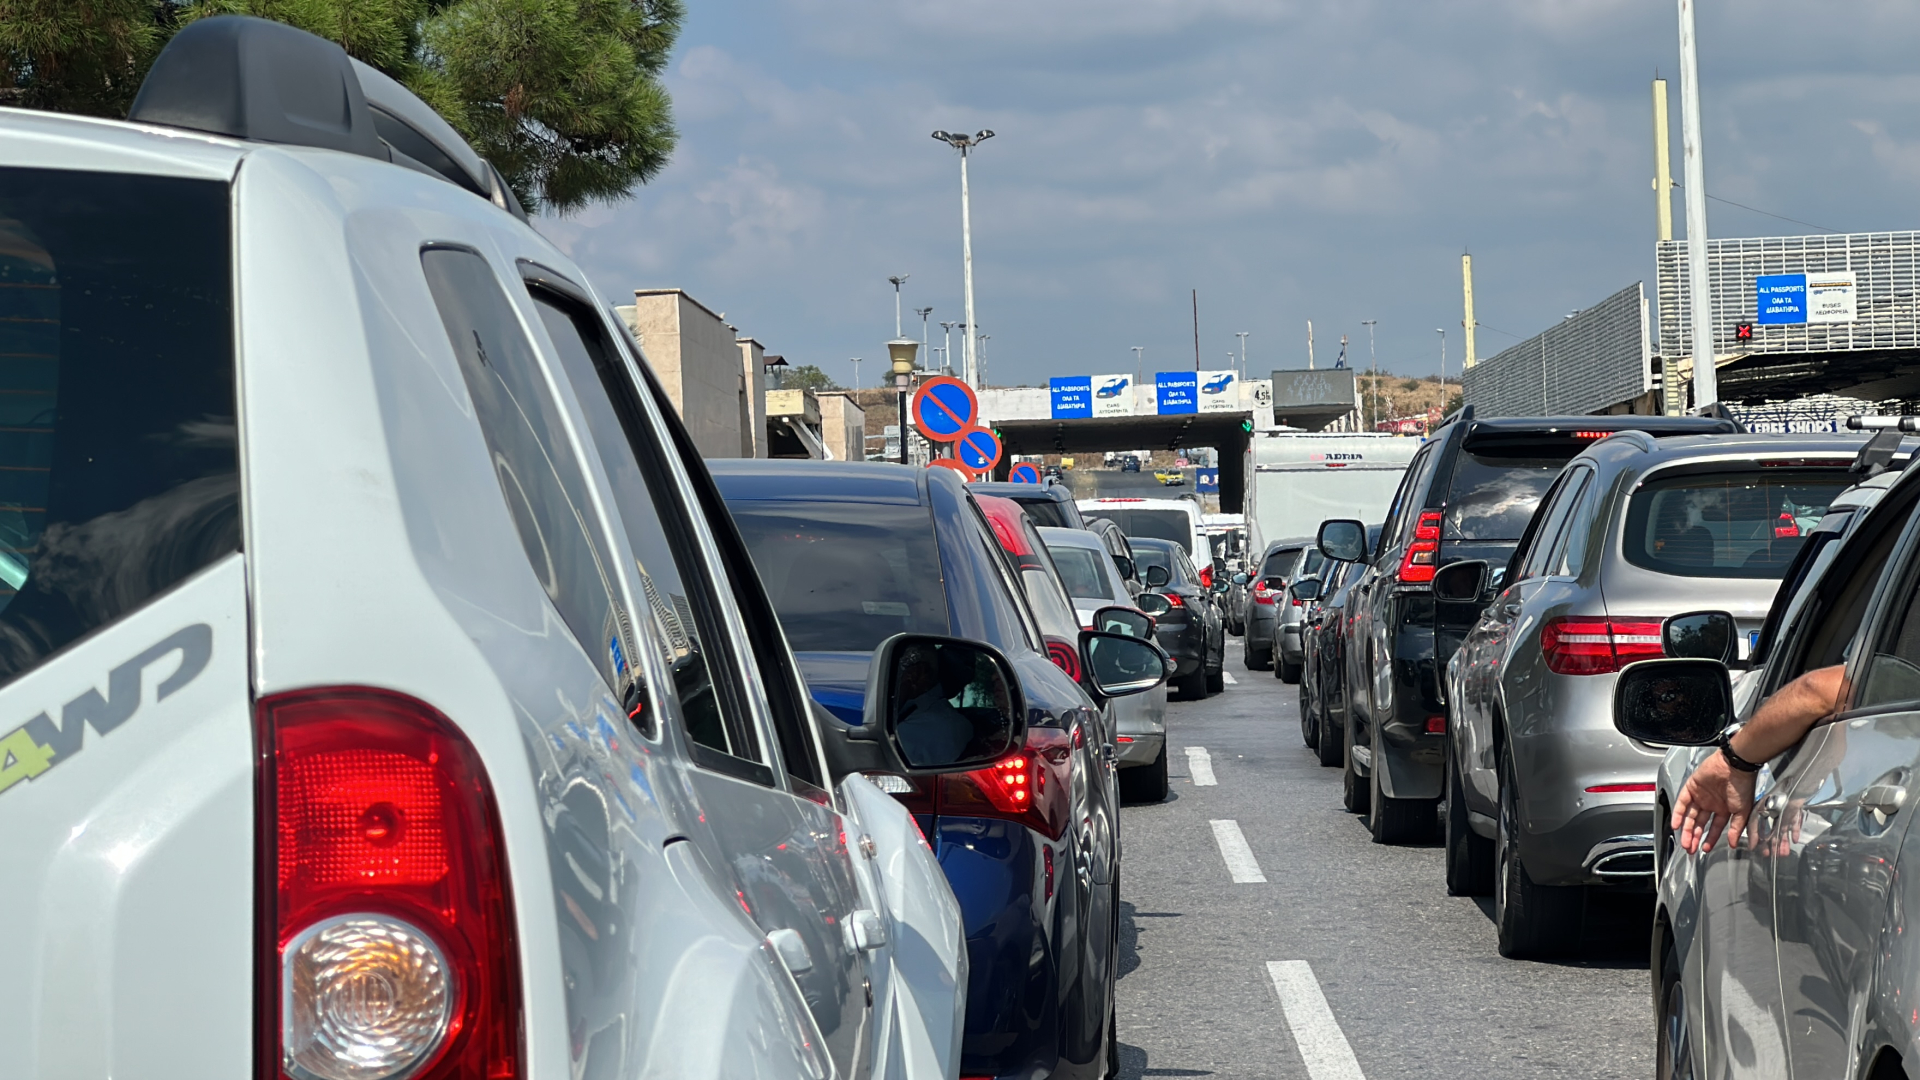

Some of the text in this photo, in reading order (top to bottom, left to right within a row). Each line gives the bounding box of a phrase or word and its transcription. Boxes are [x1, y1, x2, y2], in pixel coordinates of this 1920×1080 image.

[1770, 285, 1805, 293] PASSPORTS
[1765, 306, 1800, 314] ΔΙΑΒΑΤΗΡΙΑ
[1060, 385, 1090, 393] PASSPORTS
[1167, 381, 1196, 389] PASSPORTS
[1754, 420, 1786, 434] FREE
[1787, 419, 1833, 434] SHOPS
[0, 623, 213, 795] 4WD
